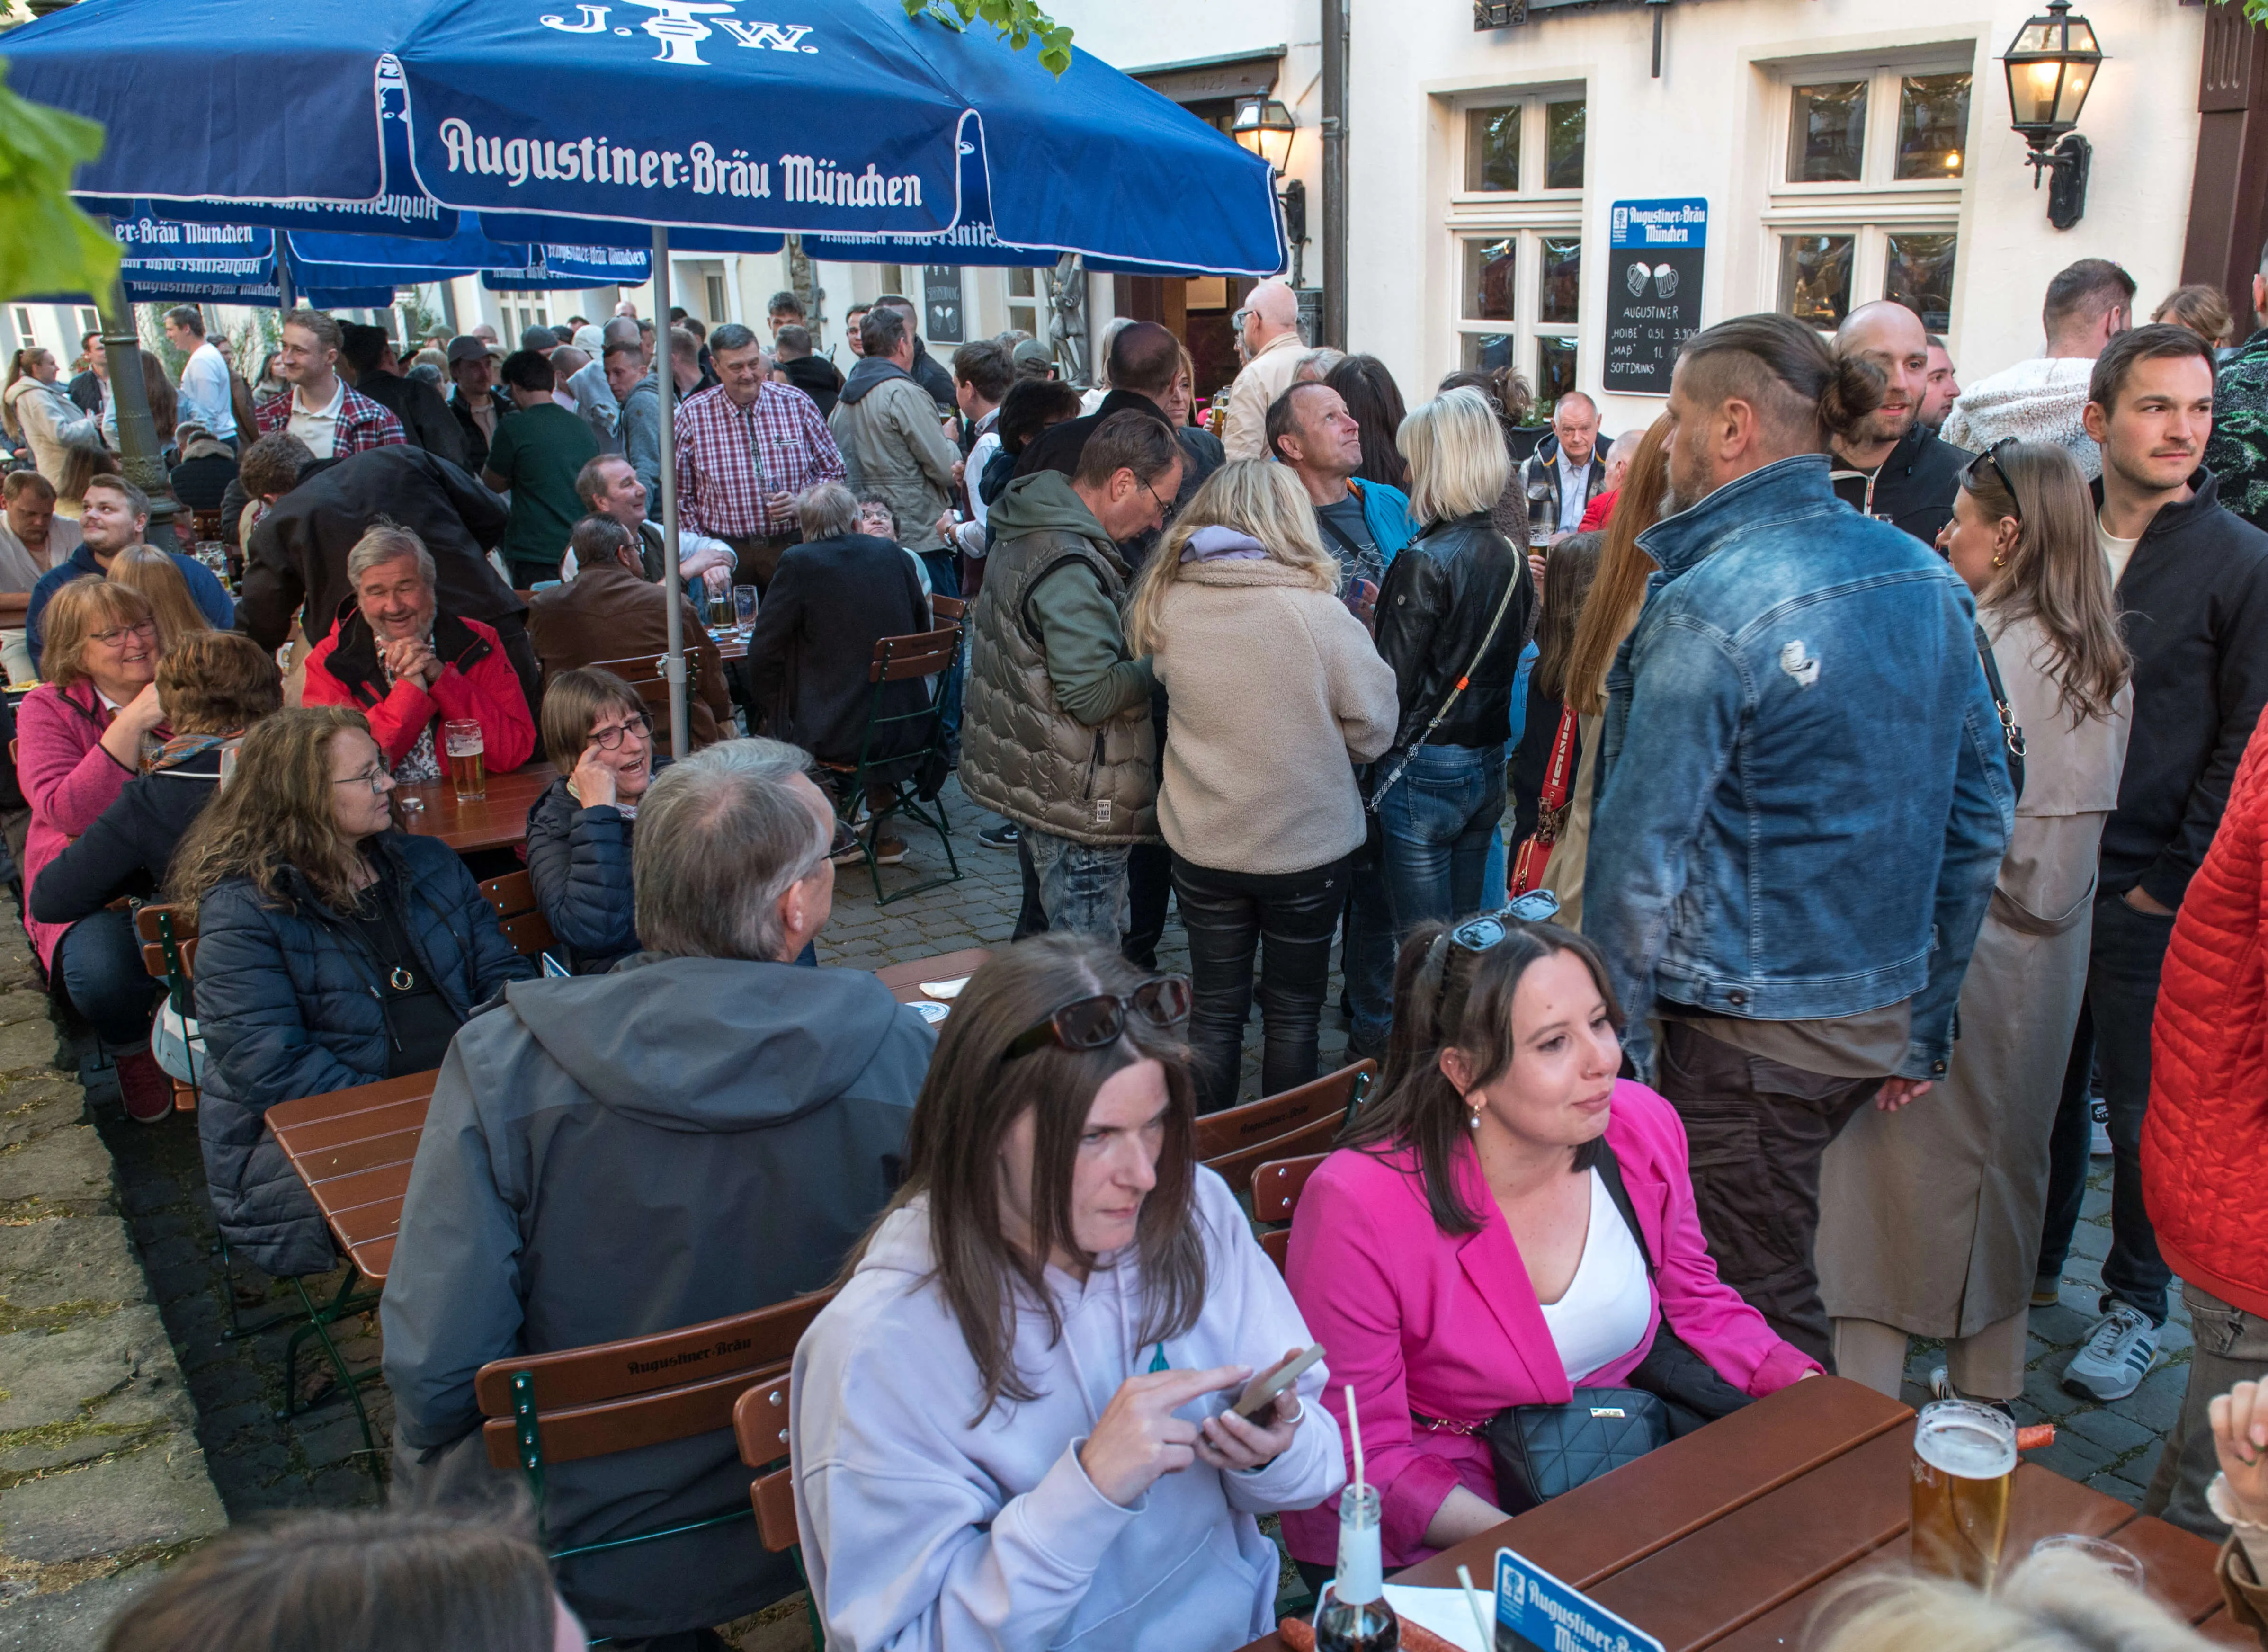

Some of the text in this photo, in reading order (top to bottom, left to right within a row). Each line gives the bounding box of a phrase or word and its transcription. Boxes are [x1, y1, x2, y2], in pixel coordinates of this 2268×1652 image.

[540, 4, 819, 54] J. W.
[780, 154, 922, 208] München
[1645, 224, 1688, 242] München
[1624, 305, 1679, 320] AUGUSTINER
[1610, 362, 1655, 374] SOFTDRINKS
